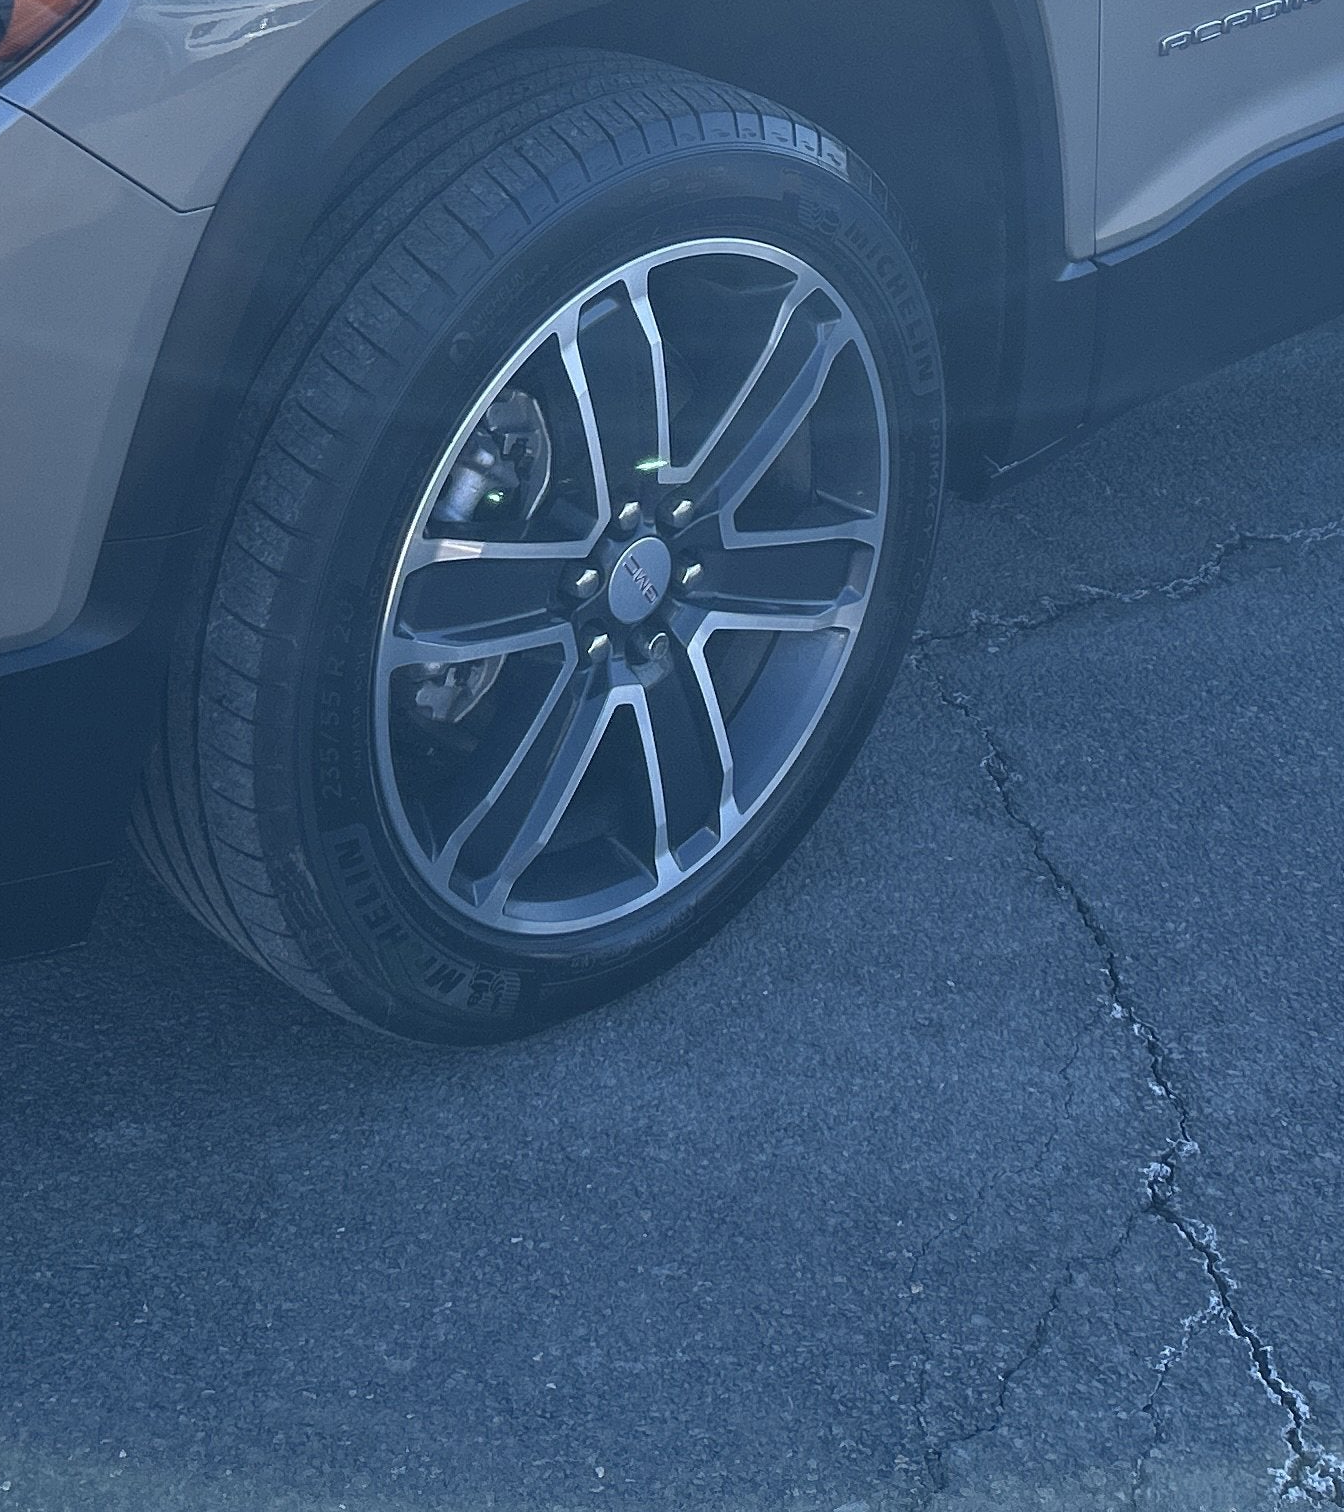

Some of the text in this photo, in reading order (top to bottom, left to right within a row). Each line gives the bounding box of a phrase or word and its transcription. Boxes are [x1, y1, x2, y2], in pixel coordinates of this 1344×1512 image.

[844, 222, 934, 382] MICHELIN
[922, 417, 941, 538] PRIMACY
[622, 553, 659, 605] GMC
[320, 690, 343, 799] 235/55
